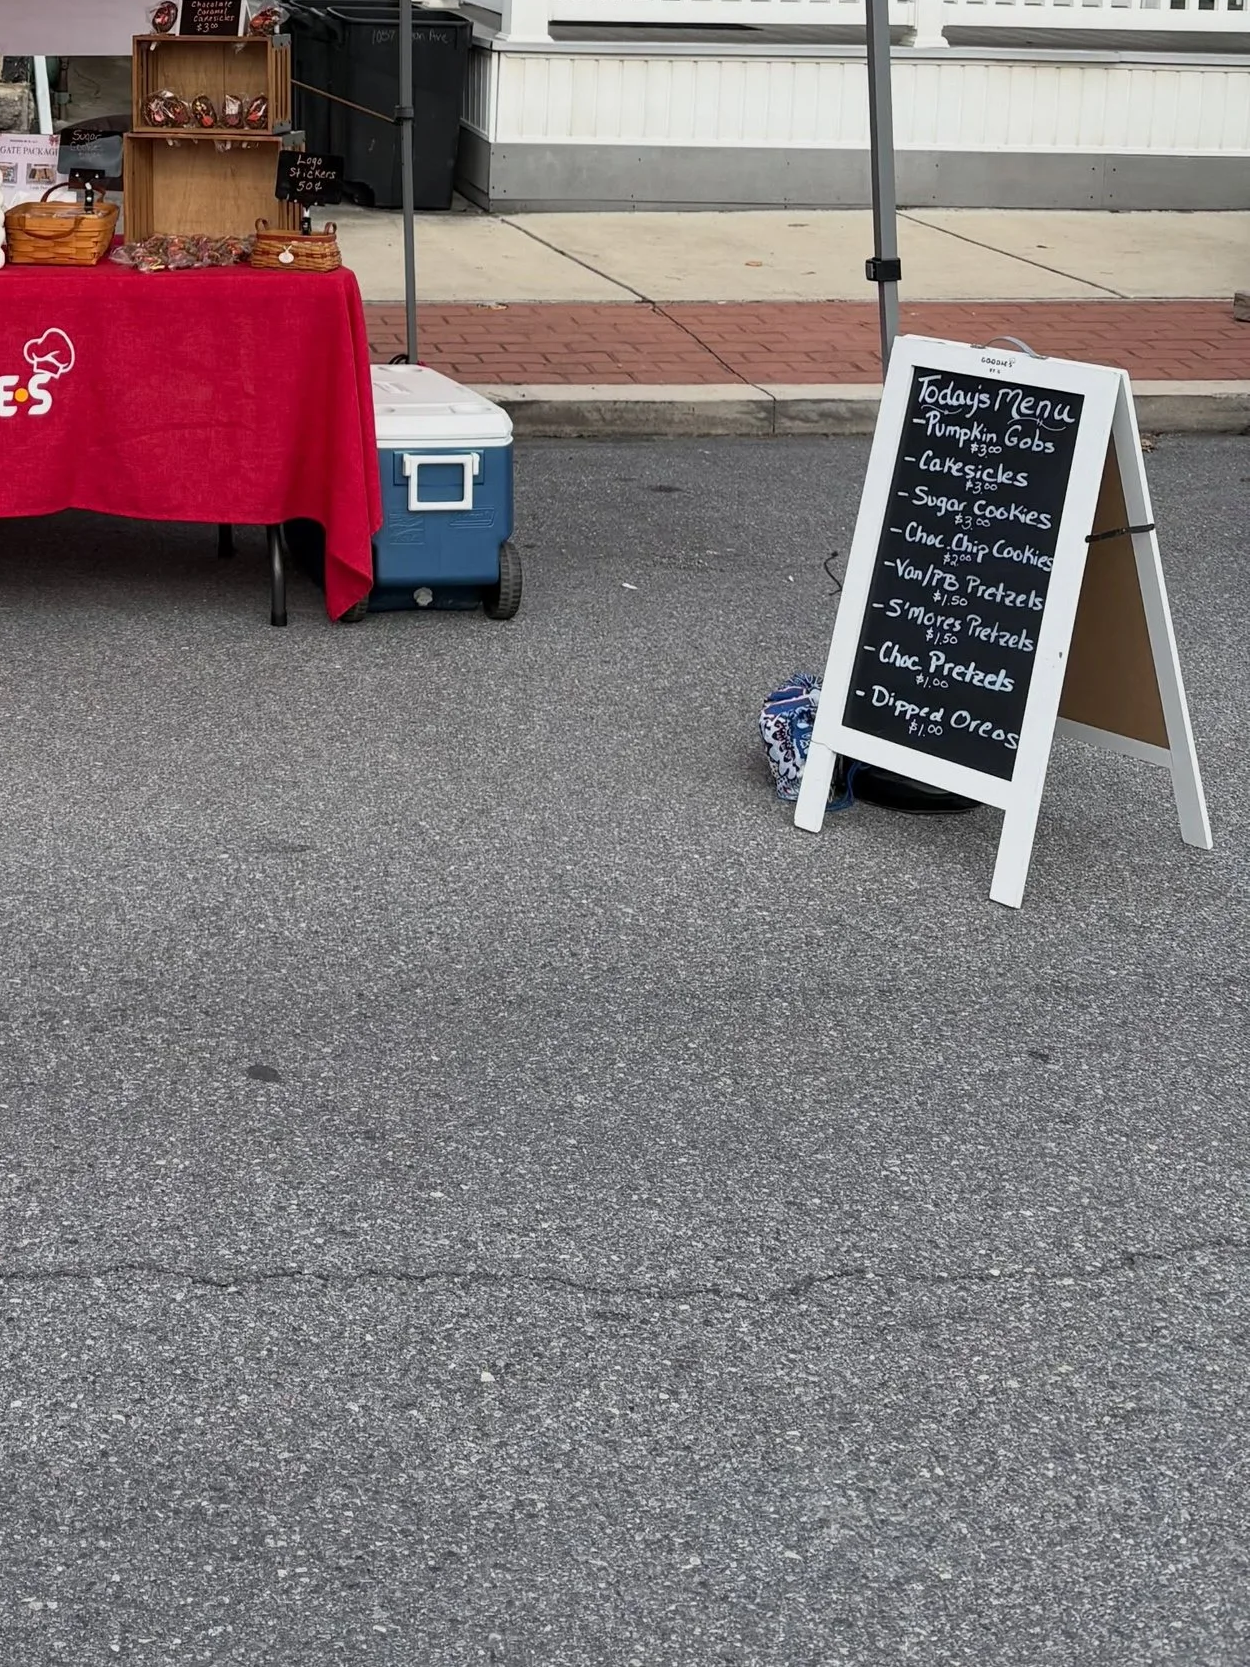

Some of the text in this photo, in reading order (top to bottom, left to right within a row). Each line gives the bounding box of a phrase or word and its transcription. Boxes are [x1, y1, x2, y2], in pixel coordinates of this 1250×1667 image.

[191, 0, 233, 8] Chocolate
[196, 7, 228, 16] Caramel
[296, 154, 323, 170] Logo
[289, 167, 337, 180] Stickers
[296, 181, 323, 192] 50¢
[918, 374, 1076, 423] Today's Menu
[1004, 425, 1055, 454] Gobs
[970, 443, 1002, 458] $3.00
[965, 479, 998, 495] $3.00
[954, 513, 991, 530] $3.00
[973, 500, 1052, 529] Cookies
[943, 551, 972, 566] $2.00
[951, 533, 989, 563] Chip
[992, 539, 1053, 572] Cookies
[932, 589, 968, 606] $1.50
[966, 575, 1045, 610] Pretzels
[925, 627, 958, 645] $1.50
[966, 614, 1034, 651] Pretzels
[928, 650, 1015, 692] Pretzels
[915, 673, 949, 689] $1.00
[908, 719, 943, 737] $1.00
[950, 710, 1020, 749] Oreos
